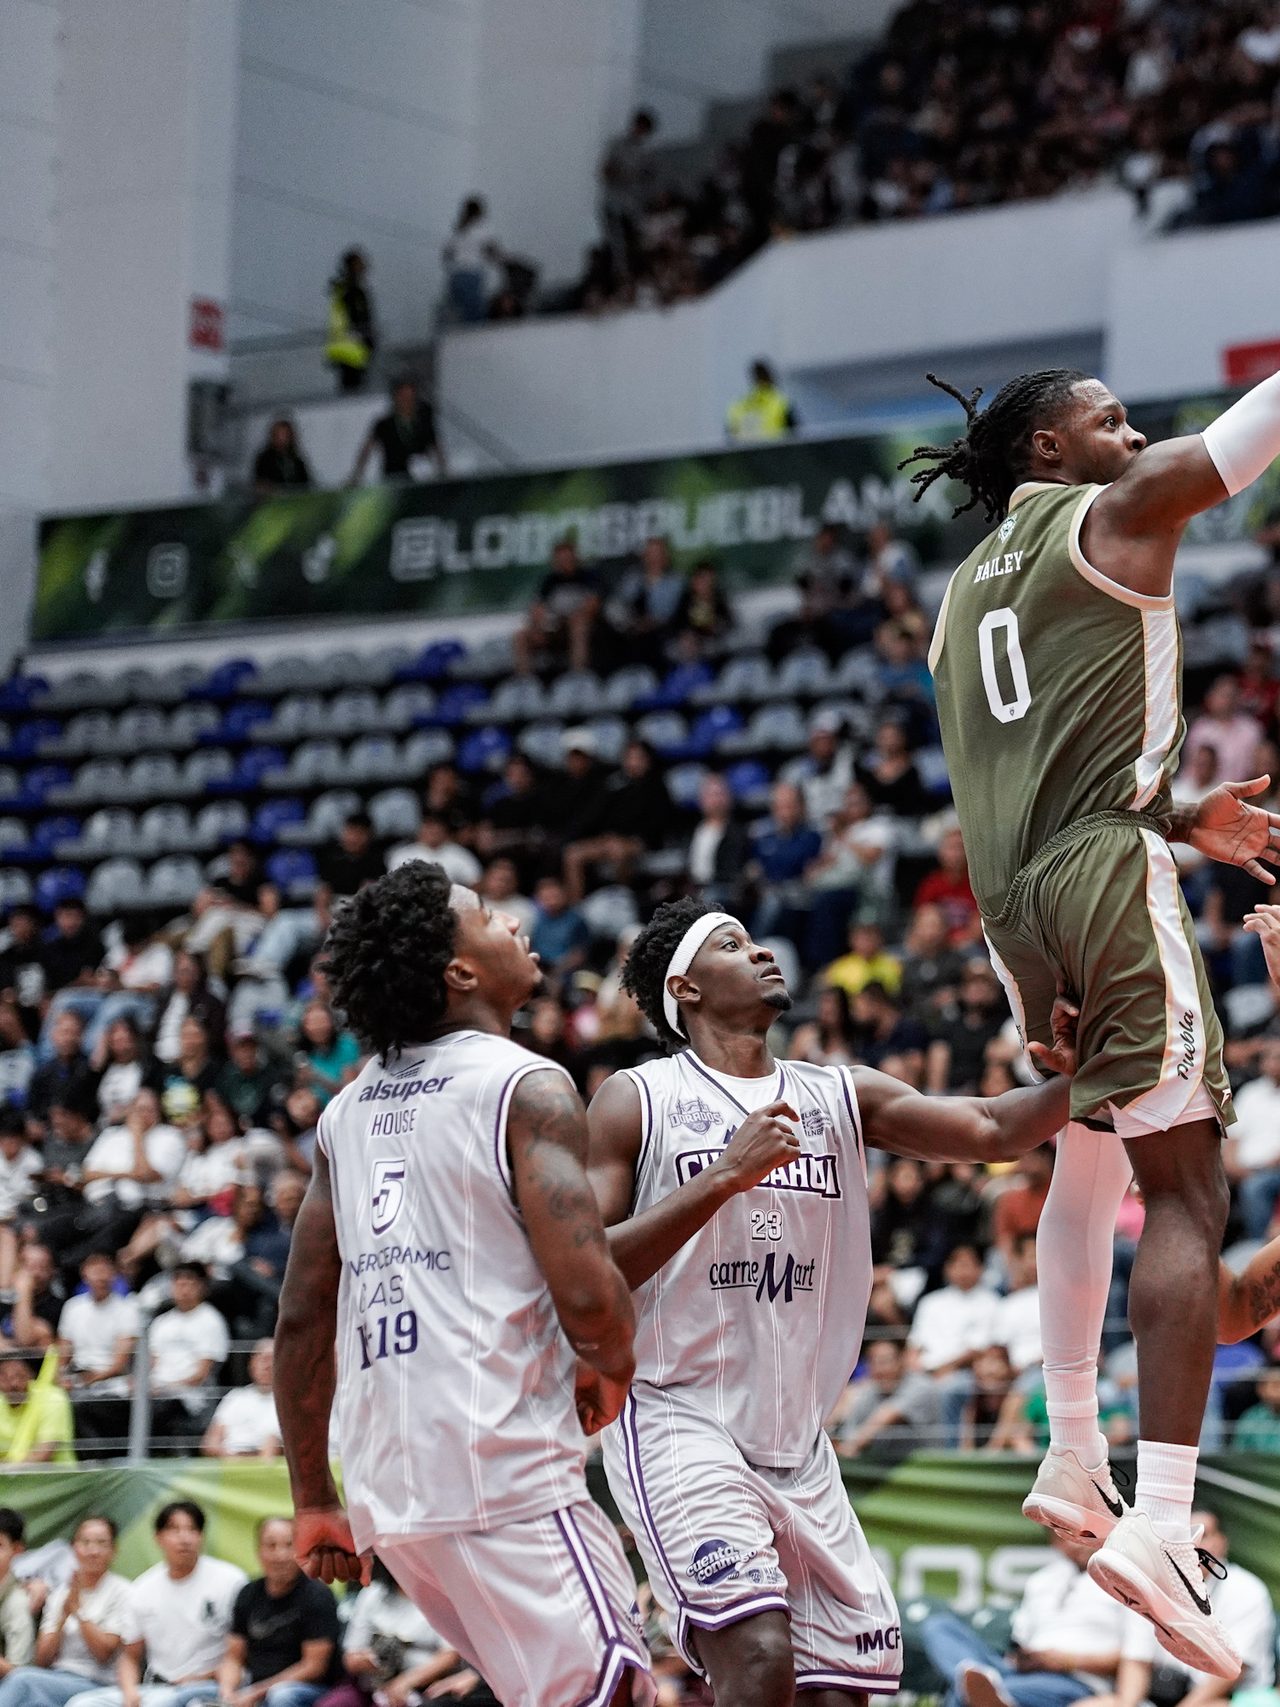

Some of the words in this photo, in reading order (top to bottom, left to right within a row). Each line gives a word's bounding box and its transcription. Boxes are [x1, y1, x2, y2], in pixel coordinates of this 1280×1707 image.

[974, 551, 1024, 584] BAILEY
[978, 607, 1032, 724] 0
[1176, 1009, 1196, 1081] Puebla
[358, 1075, 454, 1103] alsuper
[371, 1108, 417, 1137] HOUSE
[371, 1158, 406, 1237] 5
[750, 1208, 783, 1242] 23
